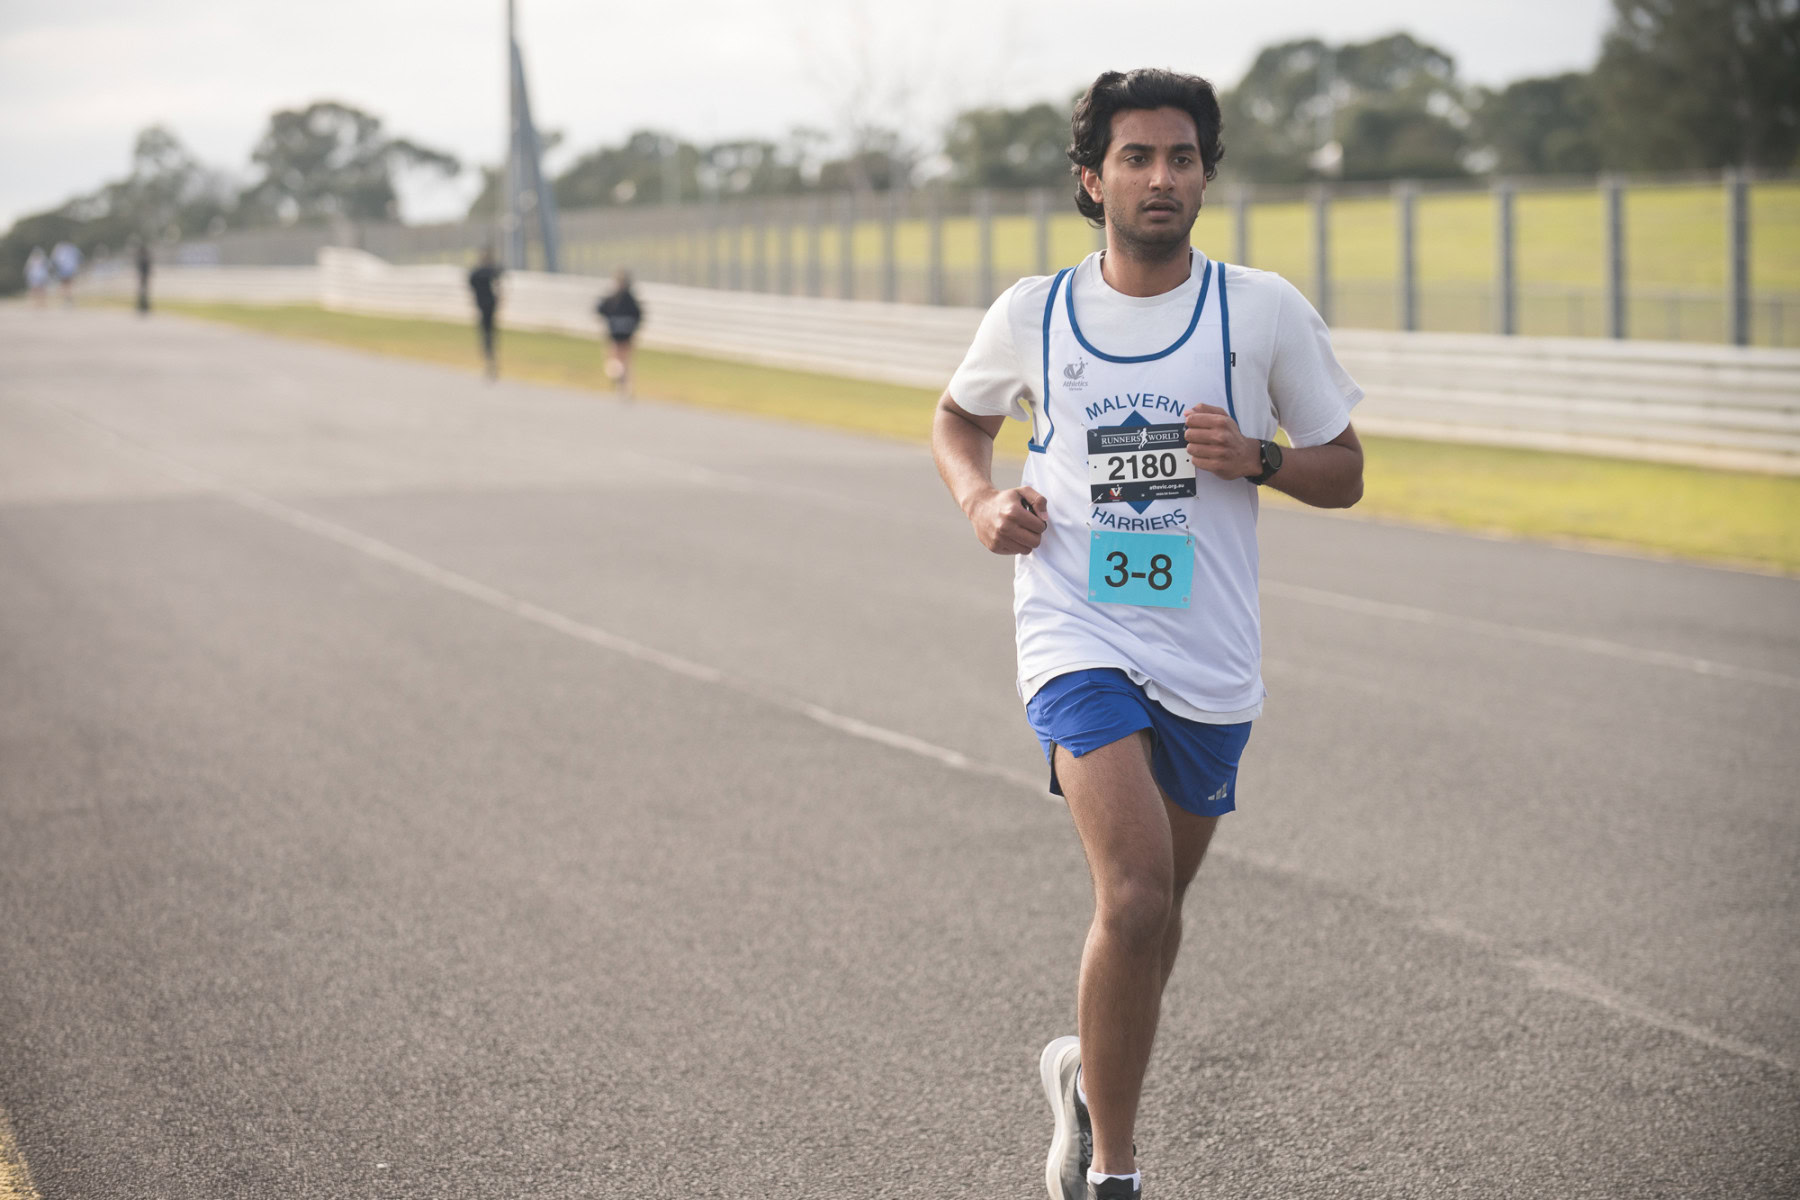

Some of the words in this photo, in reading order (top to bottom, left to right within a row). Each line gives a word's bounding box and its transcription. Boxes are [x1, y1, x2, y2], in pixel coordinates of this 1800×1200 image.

[1085, 393, 1185, 420] MALVERN
[1101, 436, 1140, 445] RUNNERS
[1148, 432, 1180, 440] WORLD
[1108, 452, 1177, 480] 2180
[1092, 506, 1187, 531] HARRIERS
[1104, 551, 1173, 591] 3-8
